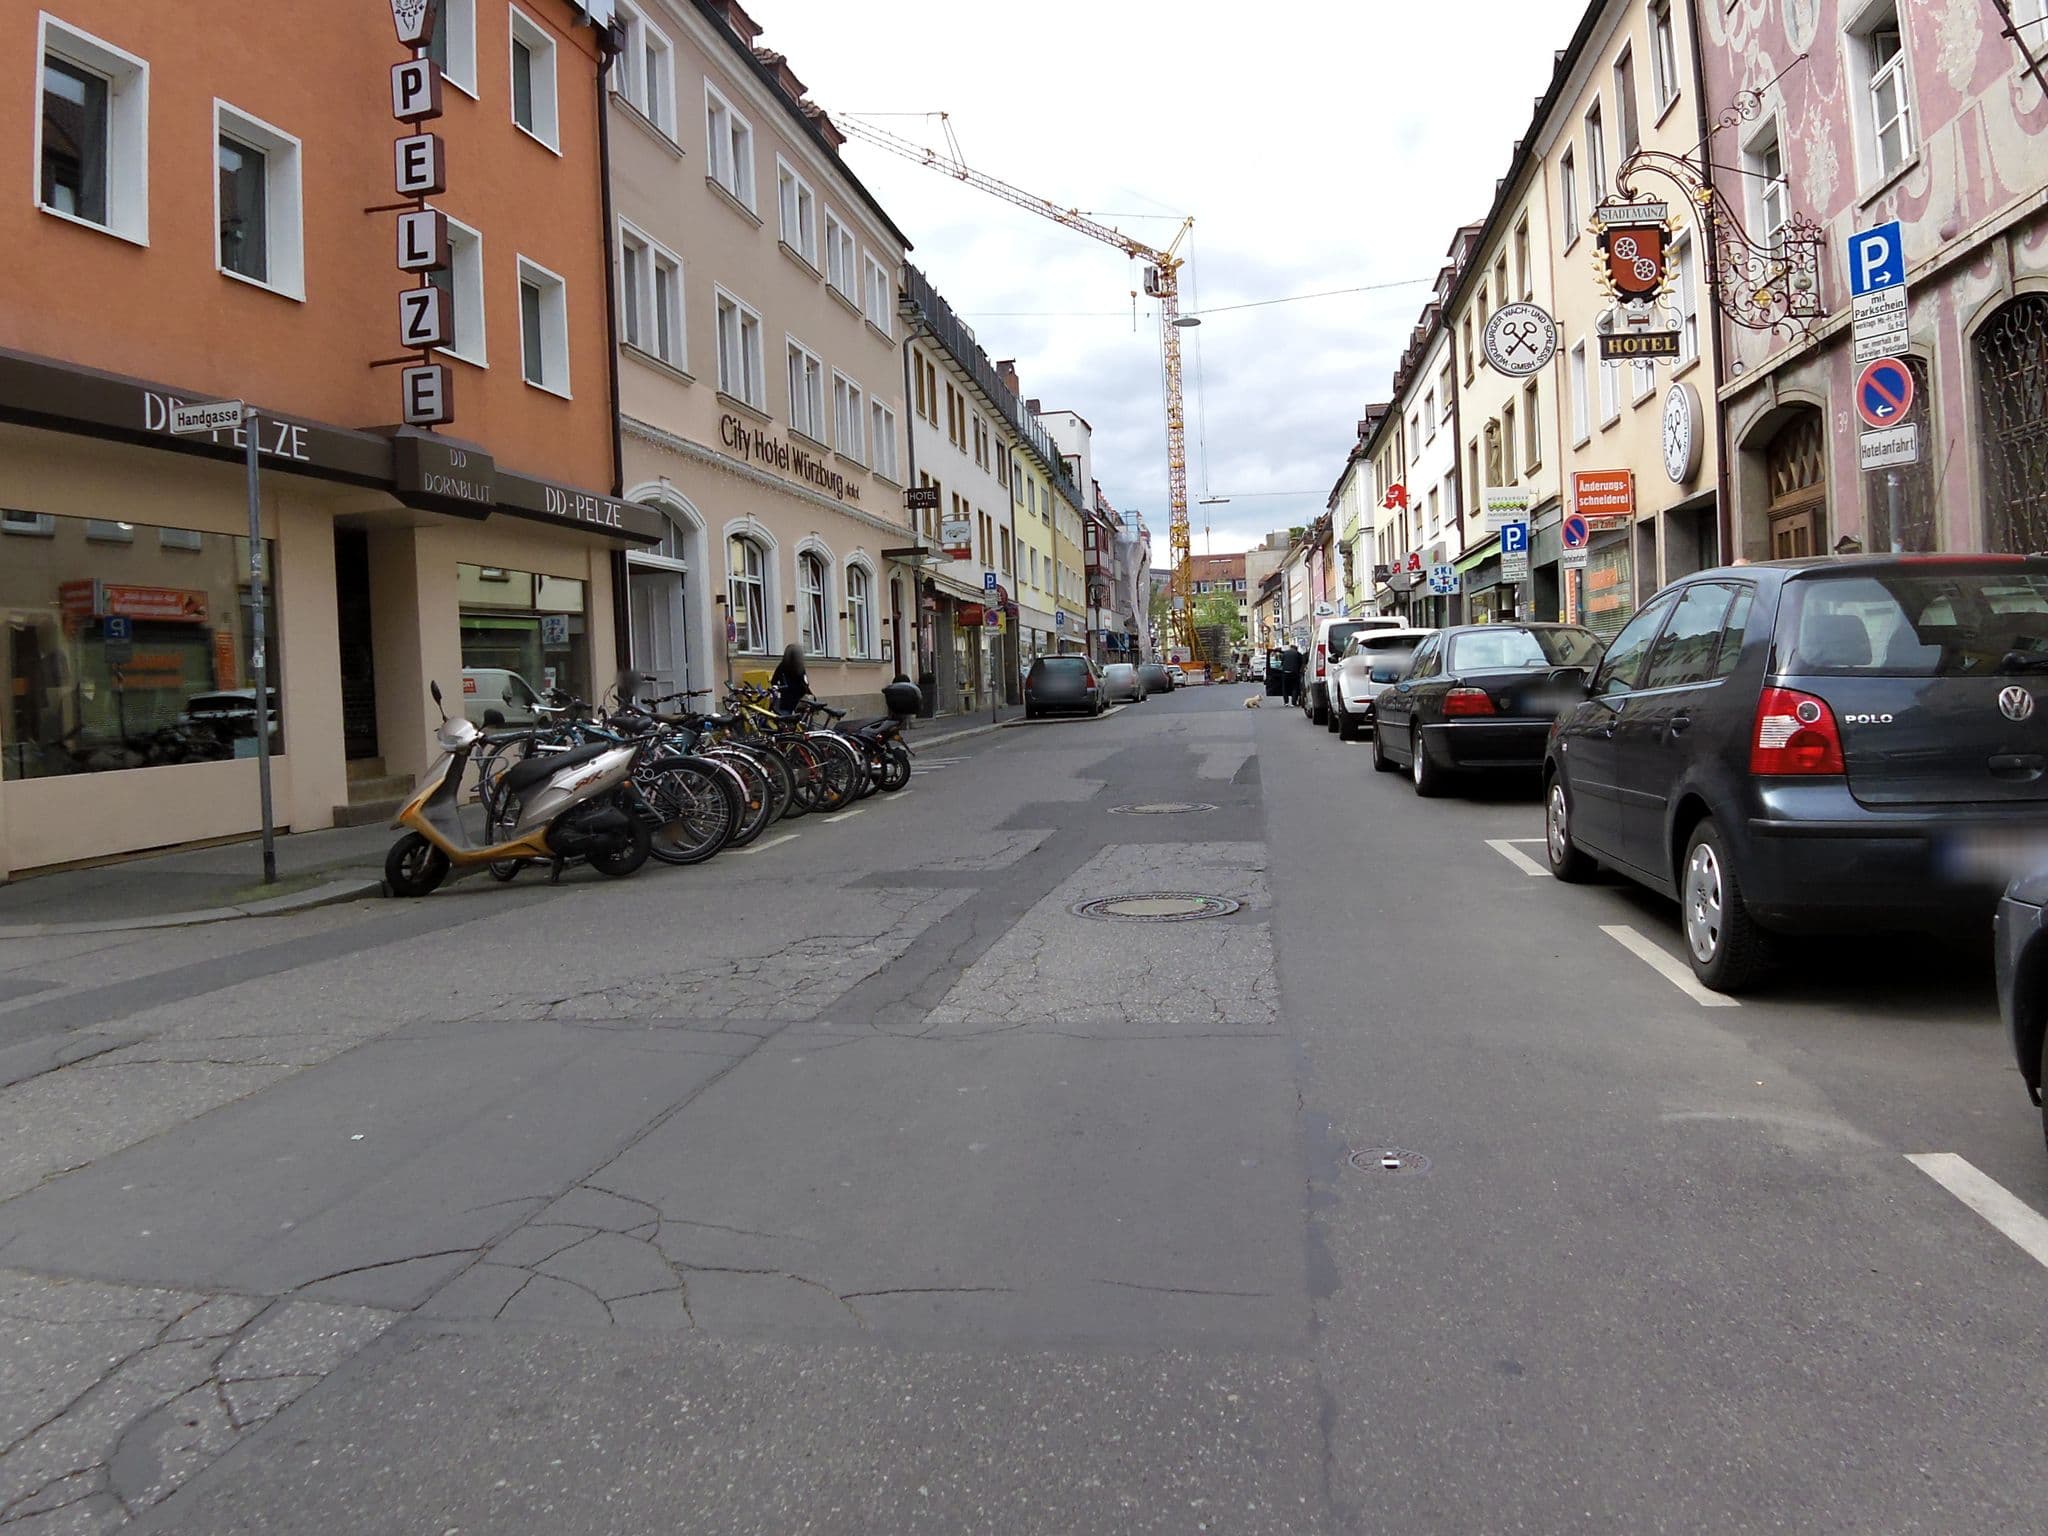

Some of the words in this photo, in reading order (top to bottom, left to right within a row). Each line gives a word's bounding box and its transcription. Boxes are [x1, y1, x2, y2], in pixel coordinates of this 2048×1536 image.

[1631, 206, 1664, 218] MAINZ
[401, 67, 435, 416] PELZE
[1860, 235, 1889, 291] P
[1854, 299, 1904, 319] Parkschein
[1871, 293, 1886, 305] mit
[1608, 336, 1676, 353] HOTEL
[1511, 360, 1536, 370] GMBH
[177, 409, 238, 428] Handgasse
[1838, 411, 1848, 432] 39
[721, 414, 751, 460] City
[755, 429, 790, 471] Hotel
[792, 446, 843, 500] Würzburg
[1861, 437, 1914, 459] Hotelanfahrt
[450, 449, 467, 469] DD
[424, 472, 489, 503] DORNBLUT
[909, 491, 937, 501] HOTEL
[545, 486, 623, 528] DD-PELZE
[1578, 493, 1628, 506] schneiderei
[1506, 527, 1521, 551] P
[1433, 566, 1452, 576] SKI
[1845, 713, 1893, 724] POLO
